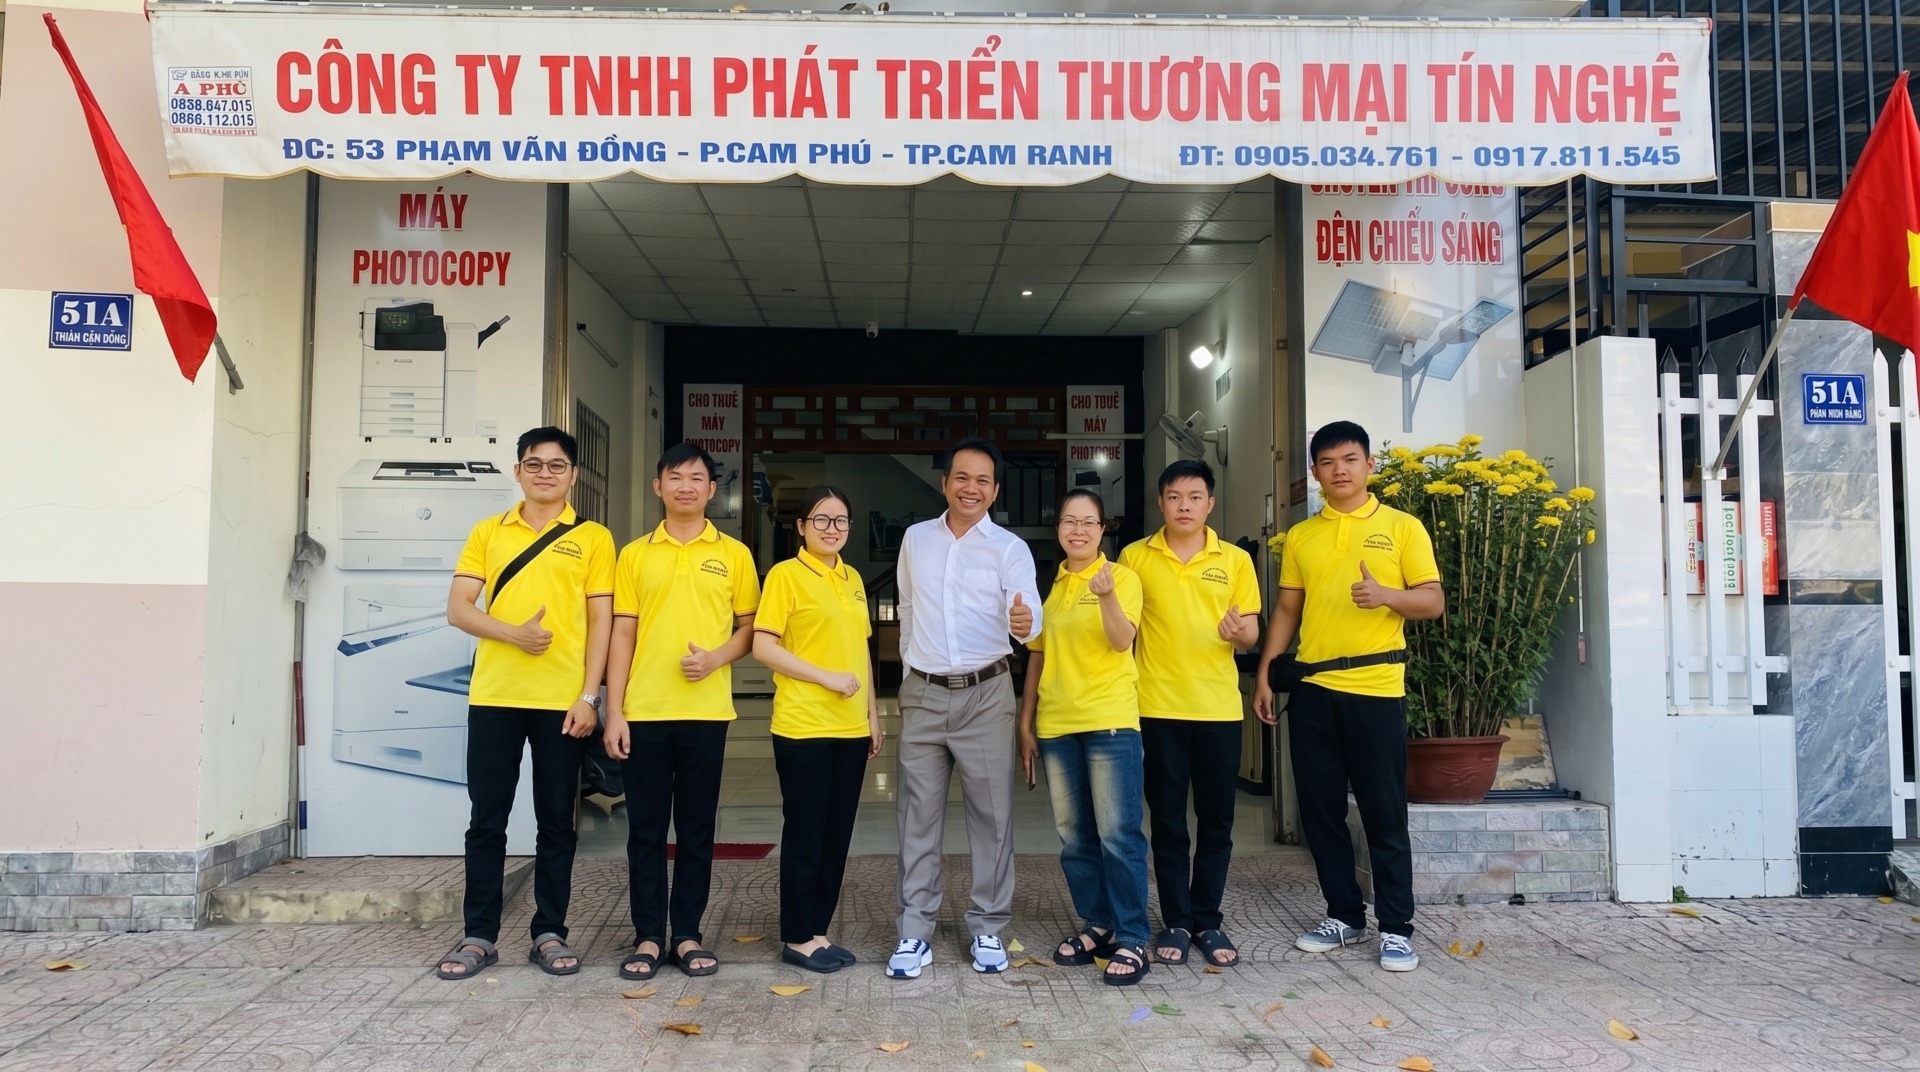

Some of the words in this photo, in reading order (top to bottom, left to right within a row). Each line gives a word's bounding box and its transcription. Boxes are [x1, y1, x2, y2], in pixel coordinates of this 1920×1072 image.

[174, 82, 190, 95] A
[276, 38, 436, 116] CÔNG
[455, 54, 521, 116] TY
[539, 55, 692, 117] TNHH
[713, 44, 858, 119] PHÁT
[876, 35, 1039, 120] TRIỂN
[1058, 55, 1281, 123] THƯƠNG
[1301, 63, 1407, 136] MẠI
[1426, 51, 1514, 123] TÍN
[1534, 52, 1681, 137] NGHỆ
[171, 112, 254, 126] 0866.112.015
[282, 138, 334, 160] ĐC:
[346, 139, 384, 160] 53
[396, 140, 491, 165] PHẠM
[577, 134, 666, 162] ĐỒNG
[700, 142, 797, 163] P.CAM
[808, 139, 871, 164] PHÚ
[904, 144, 1016, 165] TP.CAM
[1027, 145, 1112, 165] RANH
[1179, 145, 1224, 166] ĐT:
[1234, 146, 1438, 166] 0905.034.761
[1474, 145, 1681, 167] 0917.811.545
[399, 186, 469, 230] MÁY
[1369, 206, 1436, 263] CHIẾU
[1441, 212, 1504, 264] SÁNG
[352, 250, 511, 286] PHOTOCOPY
[61, 300, 123, 326] 51A
[688, 393, 709, 408] CHO
[1071, 395, 1091, 409] CHO
[1811, 380, 1859, 404] 51A
[701, 413, 725, 430] MÁY
[1084, 415, 1107, 432] MÁY
